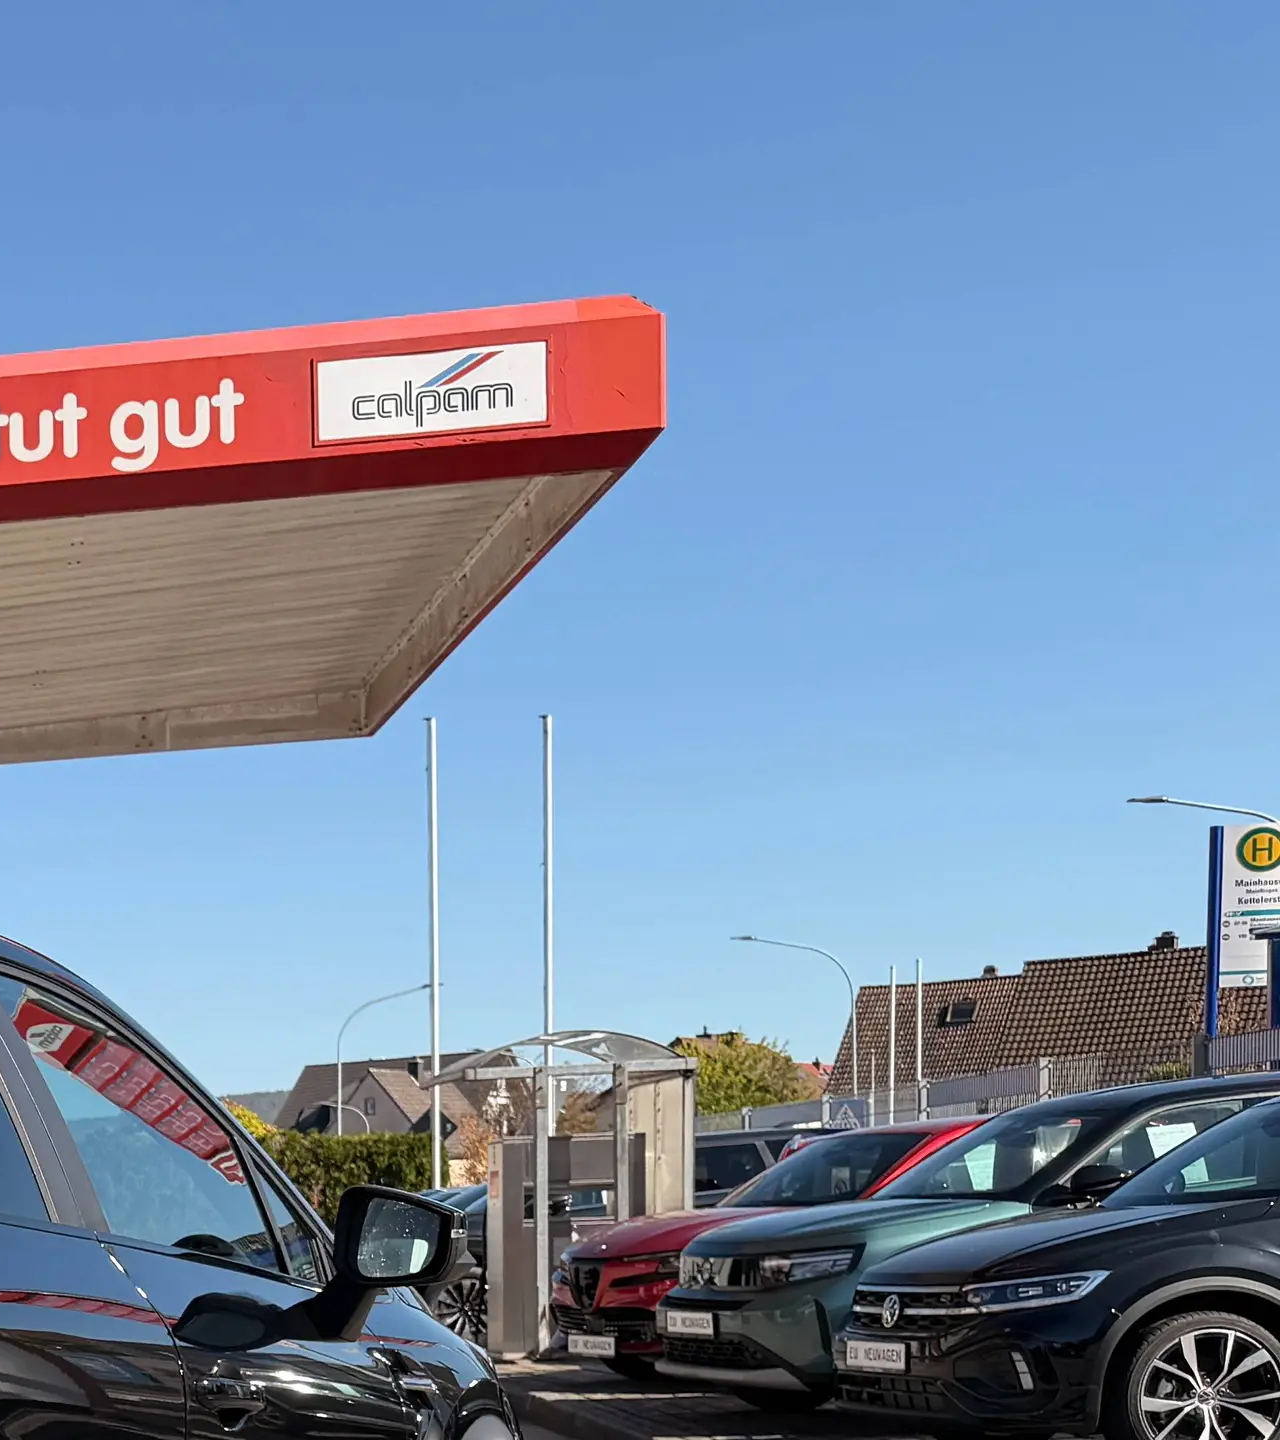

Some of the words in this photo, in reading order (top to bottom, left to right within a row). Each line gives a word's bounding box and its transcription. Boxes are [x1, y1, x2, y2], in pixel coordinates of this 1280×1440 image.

[351, 379, 514, 428] calpam
[108, 377, 246, 472] gut
[1251, 836, 1273, 862] H
[1234, 878, 1280, 888] Mainhaus
